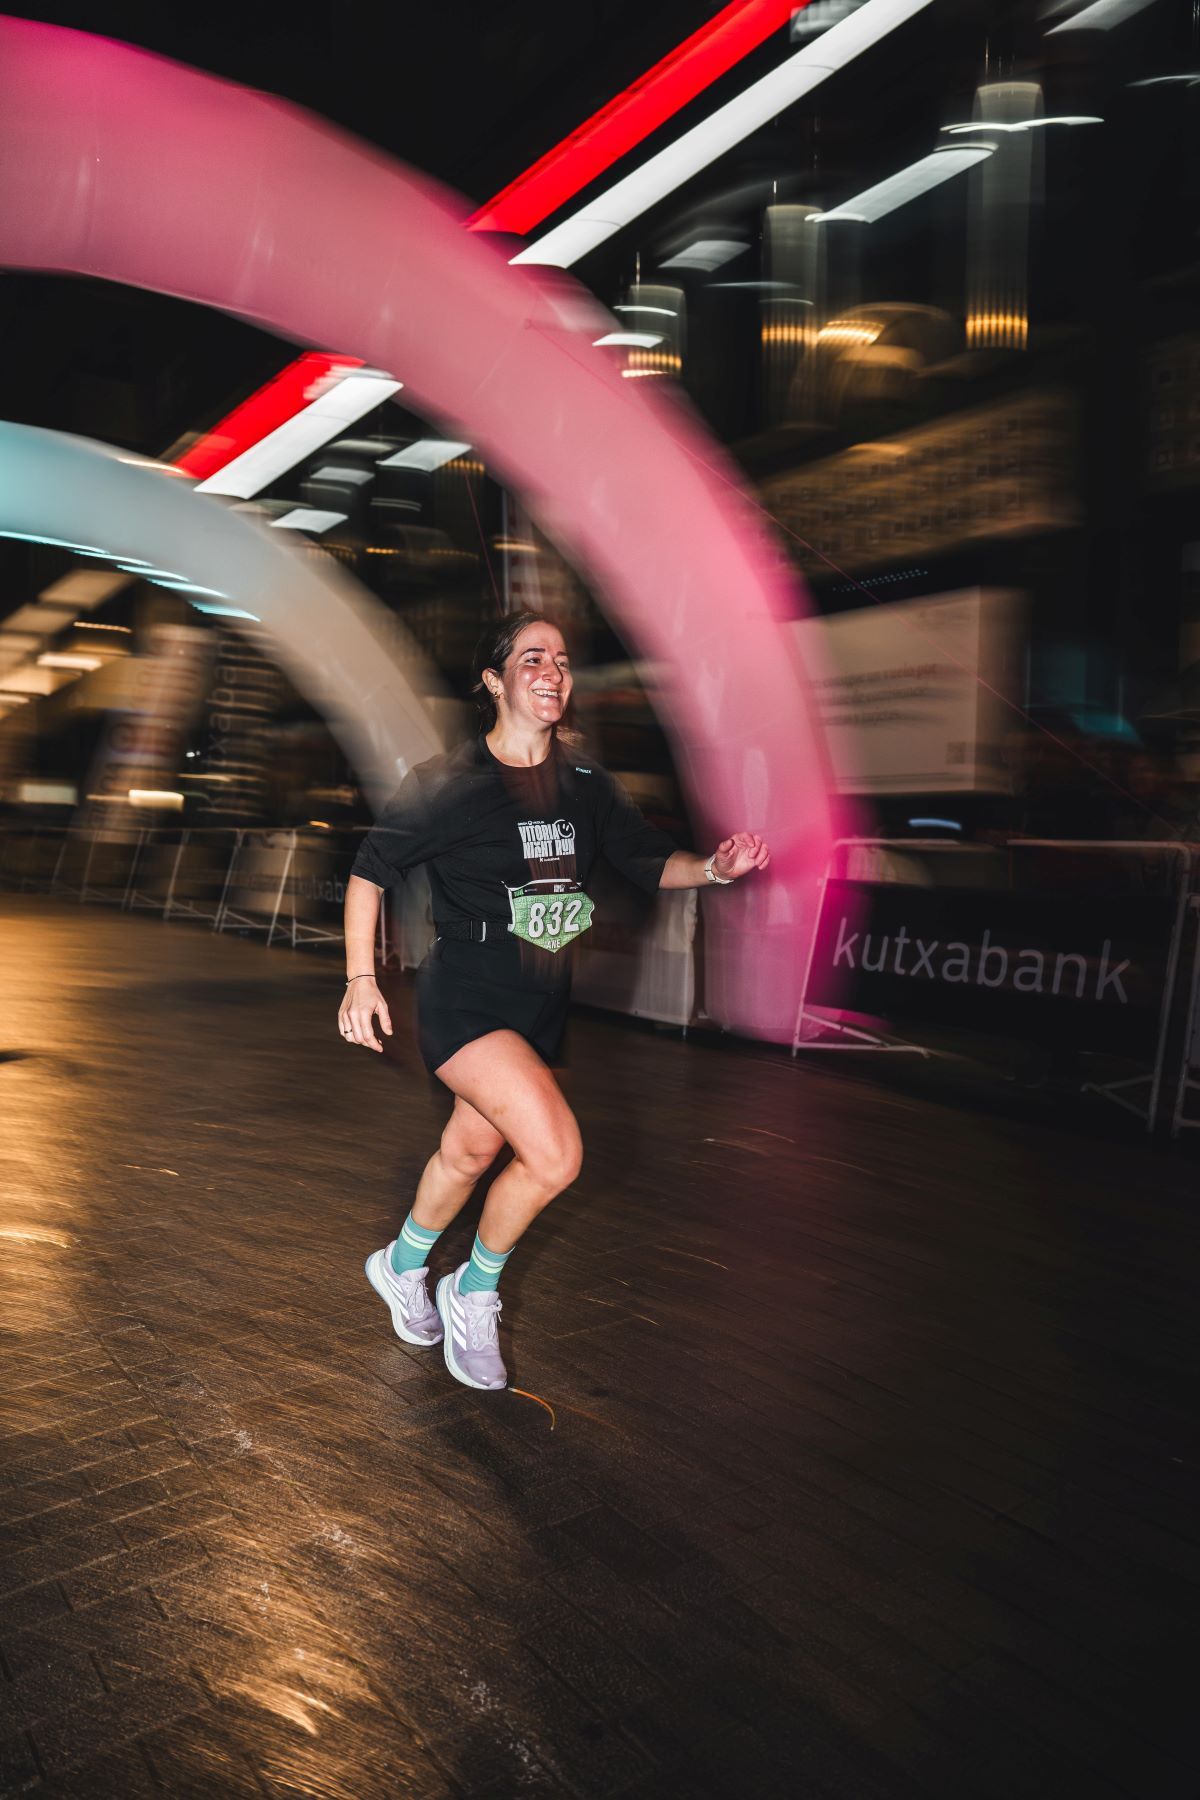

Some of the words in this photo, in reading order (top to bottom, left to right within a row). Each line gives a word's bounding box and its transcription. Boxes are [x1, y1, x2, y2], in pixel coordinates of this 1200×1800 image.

[518, 823, 560, 843] VITORIA
[523, 840, 553, 859] NIGHT
[555, 838, 575, 856] RUN
[528, 899, 582, 938] 832
[833, 917, 1131, 1004] kutxabank
